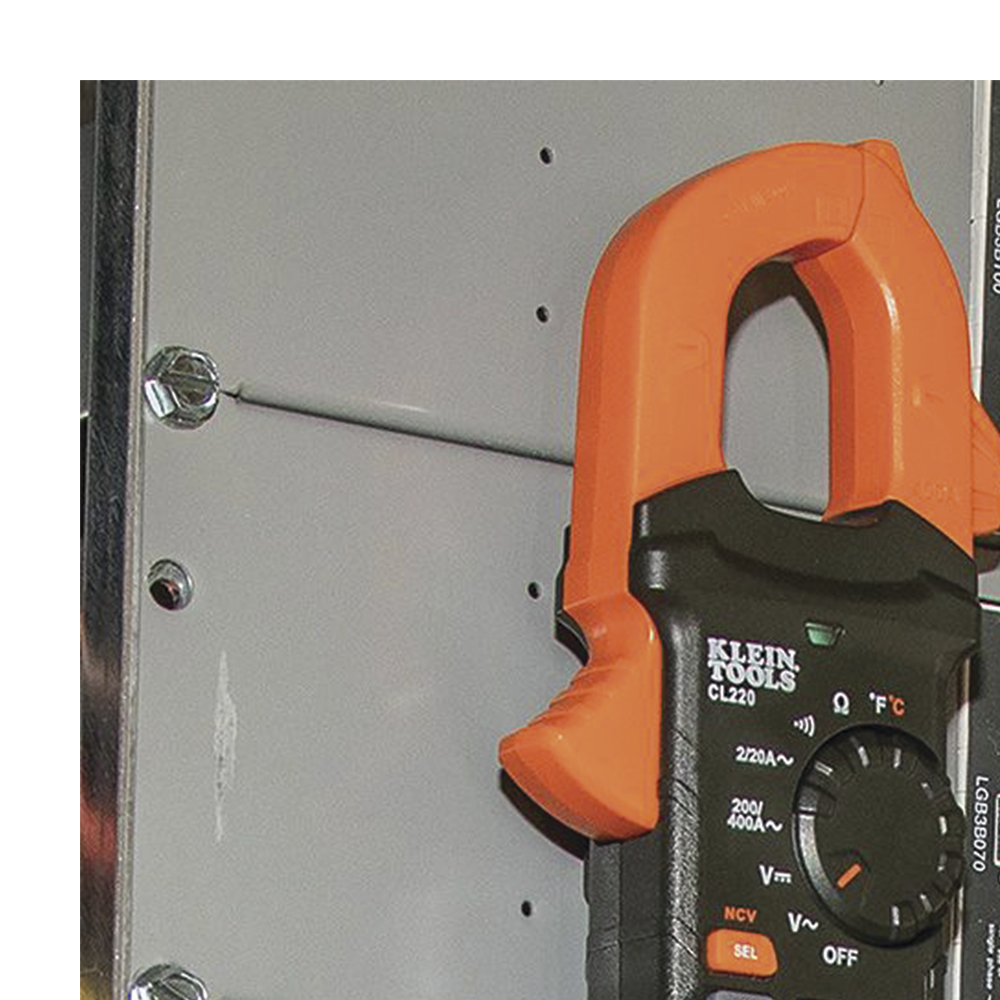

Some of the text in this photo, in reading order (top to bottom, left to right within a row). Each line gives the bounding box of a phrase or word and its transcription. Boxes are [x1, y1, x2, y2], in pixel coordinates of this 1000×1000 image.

[707, 637, 796, 670] KLEIN
[709, 659, 797, 693] TOOLS
[707, 685, 756, 706] CL220
[972, 774, 990, 873] LGB3B070
[724, 906, 757, 923] NCV
[733, 943, 758, 960] SEL
[823, 945, 859, 968] OFF
